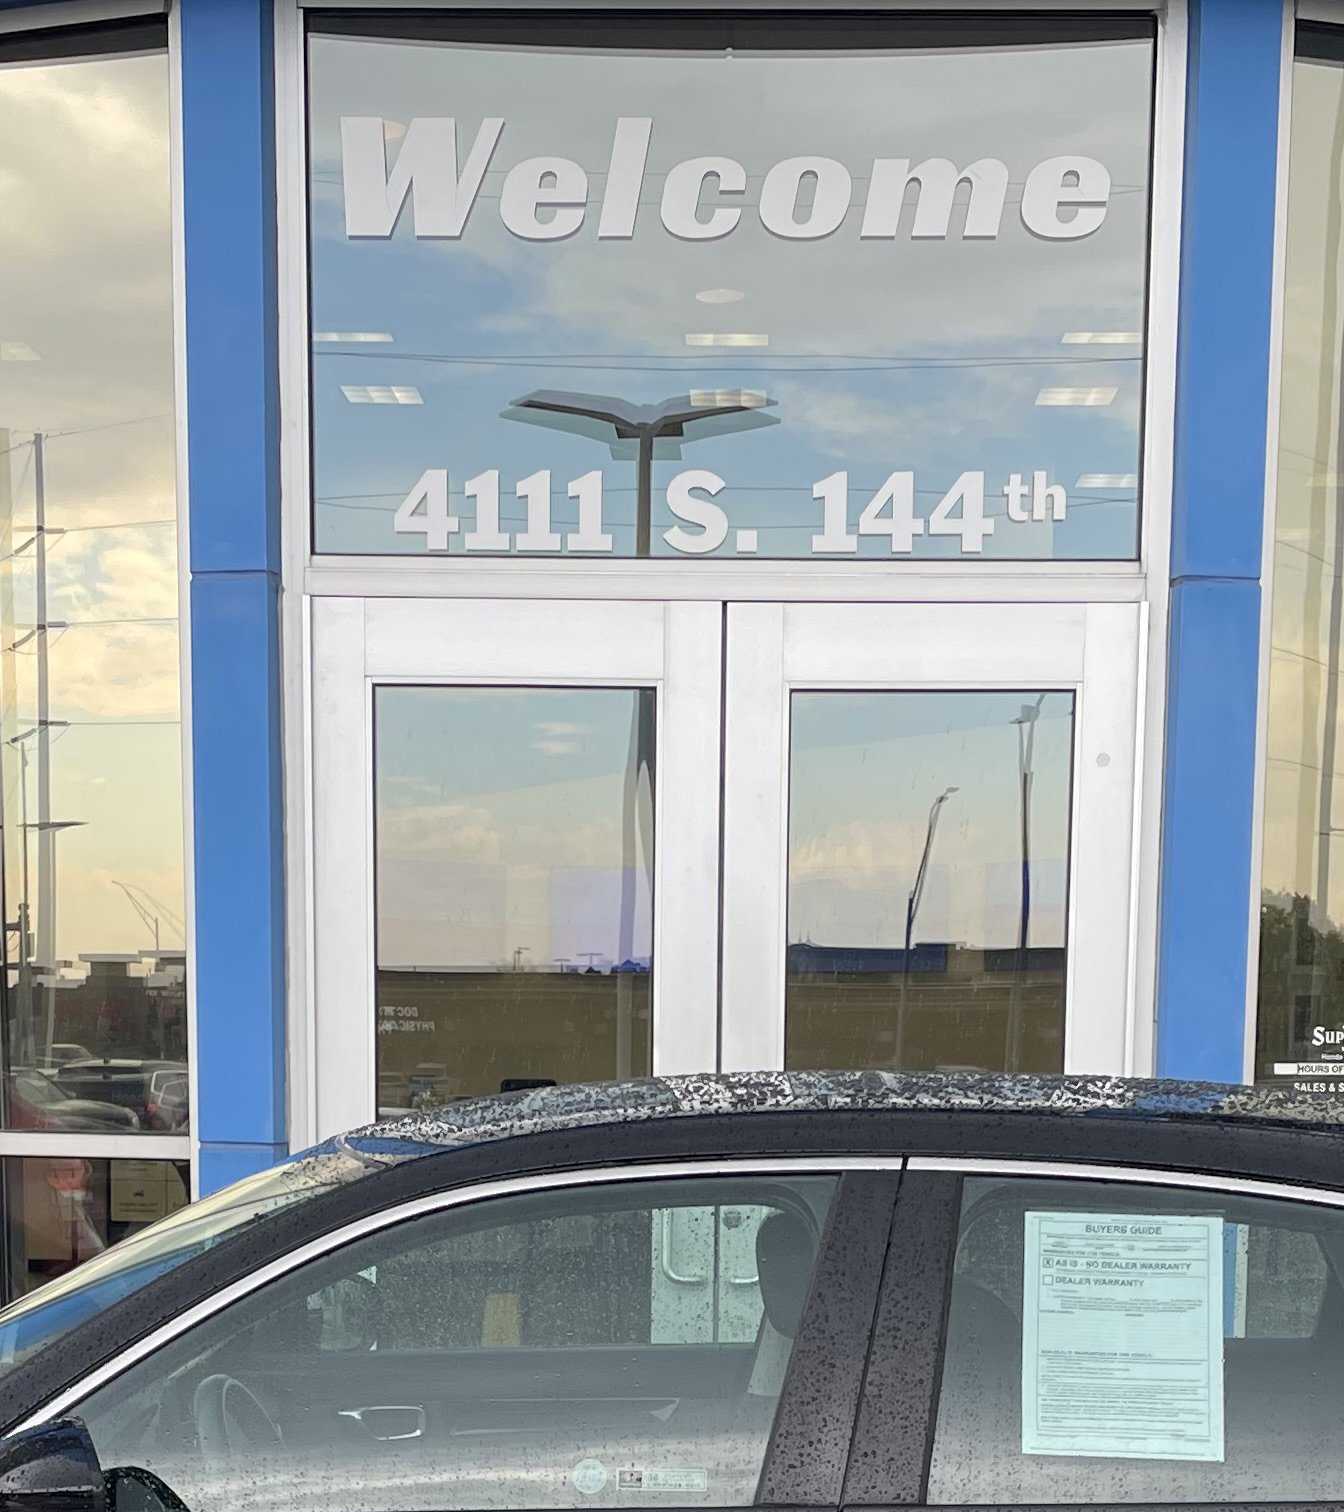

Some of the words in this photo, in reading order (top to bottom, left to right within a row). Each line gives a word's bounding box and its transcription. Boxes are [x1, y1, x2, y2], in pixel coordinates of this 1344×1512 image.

[340, 116, 1112, 242] Welcome
[394, 469, 613, 552] 4111
[662, 469, 757, 554] S.
[811, 470, 1067, 554] 144th
[1297, 1064, 1330, 1073] HOURS
[1331, 1065, 1344, 1073] OF
[1293, 1082, 1326, 1093] SALES
[1328, 1083, 1336, 1093] &
[1084, 1224, 1129, 1235] BUYERS
[1130, 1225, 1163, 1236] GUIDE
[1085, 1260, 1099, 1269] NO
[1101, 1261, 1138, 1270] DEALER
[1139, 1262, 1192, 1272] WARRANTY
[1055, 1276, 1091, 1285] DEALER
[1093, 1278, 1145, 1288] WARRANTY
